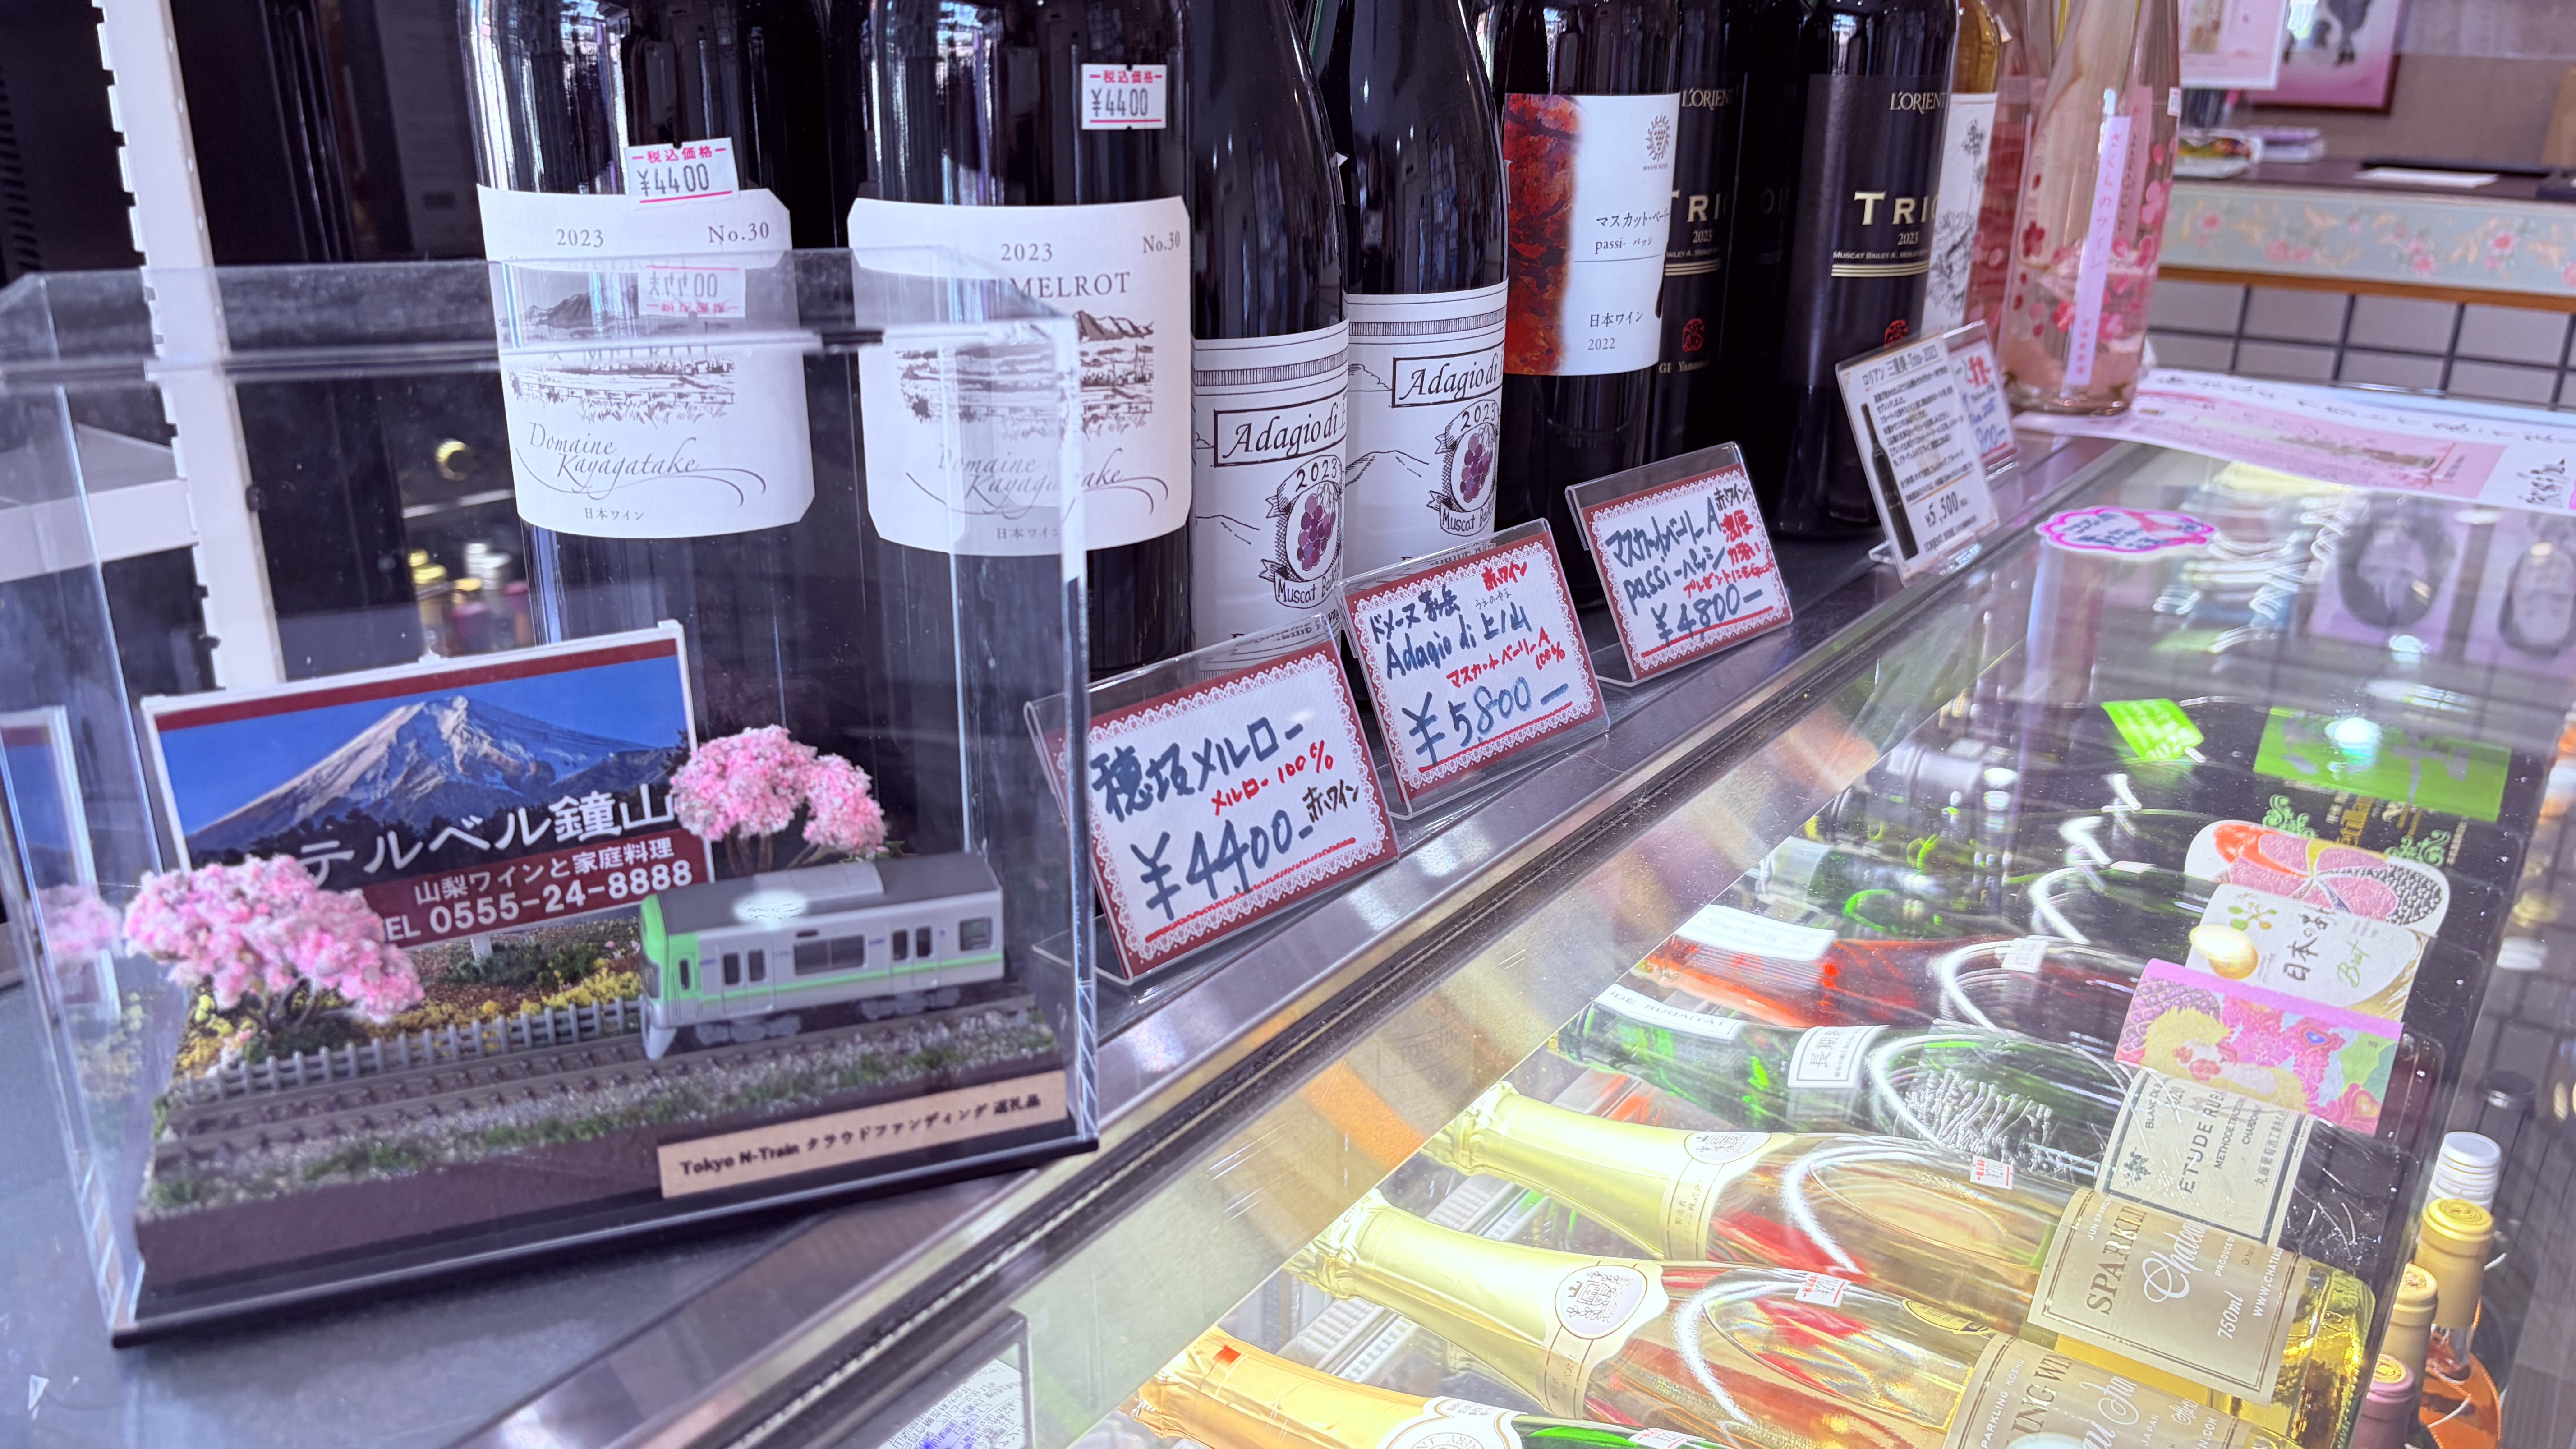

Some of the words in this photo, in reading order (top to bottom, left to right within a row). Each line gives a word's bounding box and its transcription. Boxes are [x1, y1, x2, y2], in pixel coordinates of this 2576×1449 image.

[1104, 69, 1154, 84] 税込価格
[1091, 88, 1148, 116] ¥4400
[647, 145, 714, 164] 税込価格
[638, 163, 710, 197] ¥4400
[1672, 189, 1727, 223] RI
[557, 229, 603, 247] 2023
[708, 222, 769, 243] No.30
[1000, 243, 1053, 262] 2023
[1143, 232, 1181, 254] No.30
[1693, 229, 1712, 243] 2023
[1898, 231, 1918, 245] 2023
[1010, 272, 1131, 299] MELROT
[1590, 312, 1642, 327] 日本ワイン
[1587, 338, 1615, 350] 2022
[1399, 361, 1484, 400] Adagio
[1486, 355, 1497, 385] di
[1223, 413, 1320, 458] Adagio
[1323, 404, 1338, 442] di
[1461, 403, 1496, 431] 2023
[529, 422, 616, 455] Domaine
[558, 437, 699, 500] Kayagatake
[938, 444, 1037, 474] Domaine
[965, 448, 1123, 520] Kayagaake
[1297, 459, 1338, 492] 2023
[1714, 483, 1749, 511] 赤ワイン
[585, 507, 645, 521] 日本ワイン
[1443, 508, 1475, 531] Muscat
[1278, 581, 1317, 604] Muscat
[1481, 562, 1527, 591] 赤ワイン
[1386, 631, 1452, 680] Adagio
[1459, 614, 1477, 649] di
[1302, 780, 1359, 823] 赤ワイン
[299, 783, 675, 887] テルベル鐘山
[414, 837, 676, 905] 山梨ワインと家庭料理
[385, 914, 422, 942] EL
[429, 859, 693, 934] 0555-24-8888
[681, 1153, 734, 1176] Tokyo
[739, 1143, 800, 1165] N-Train
[806, 1103, 989, 1152] クラウドファンディング
[2179, 1121, 2212, 1194] ETUDE
[2203, 1090, 2226, 1118] RUBA
[2214, 1126, 2234, 1169] METHODE
[2088, 1223, 2098, 1240] JUN
[2217, 1291, 2244, 1339] 750ml
[1980, 1390, 2008, 1449] PARKLING
[2006, 1359, 2024, 1386] KOSHU
[2142, 1414, 2160, 1447] JAPAN
[2197, 1417, 2218, 1449] N.COM
